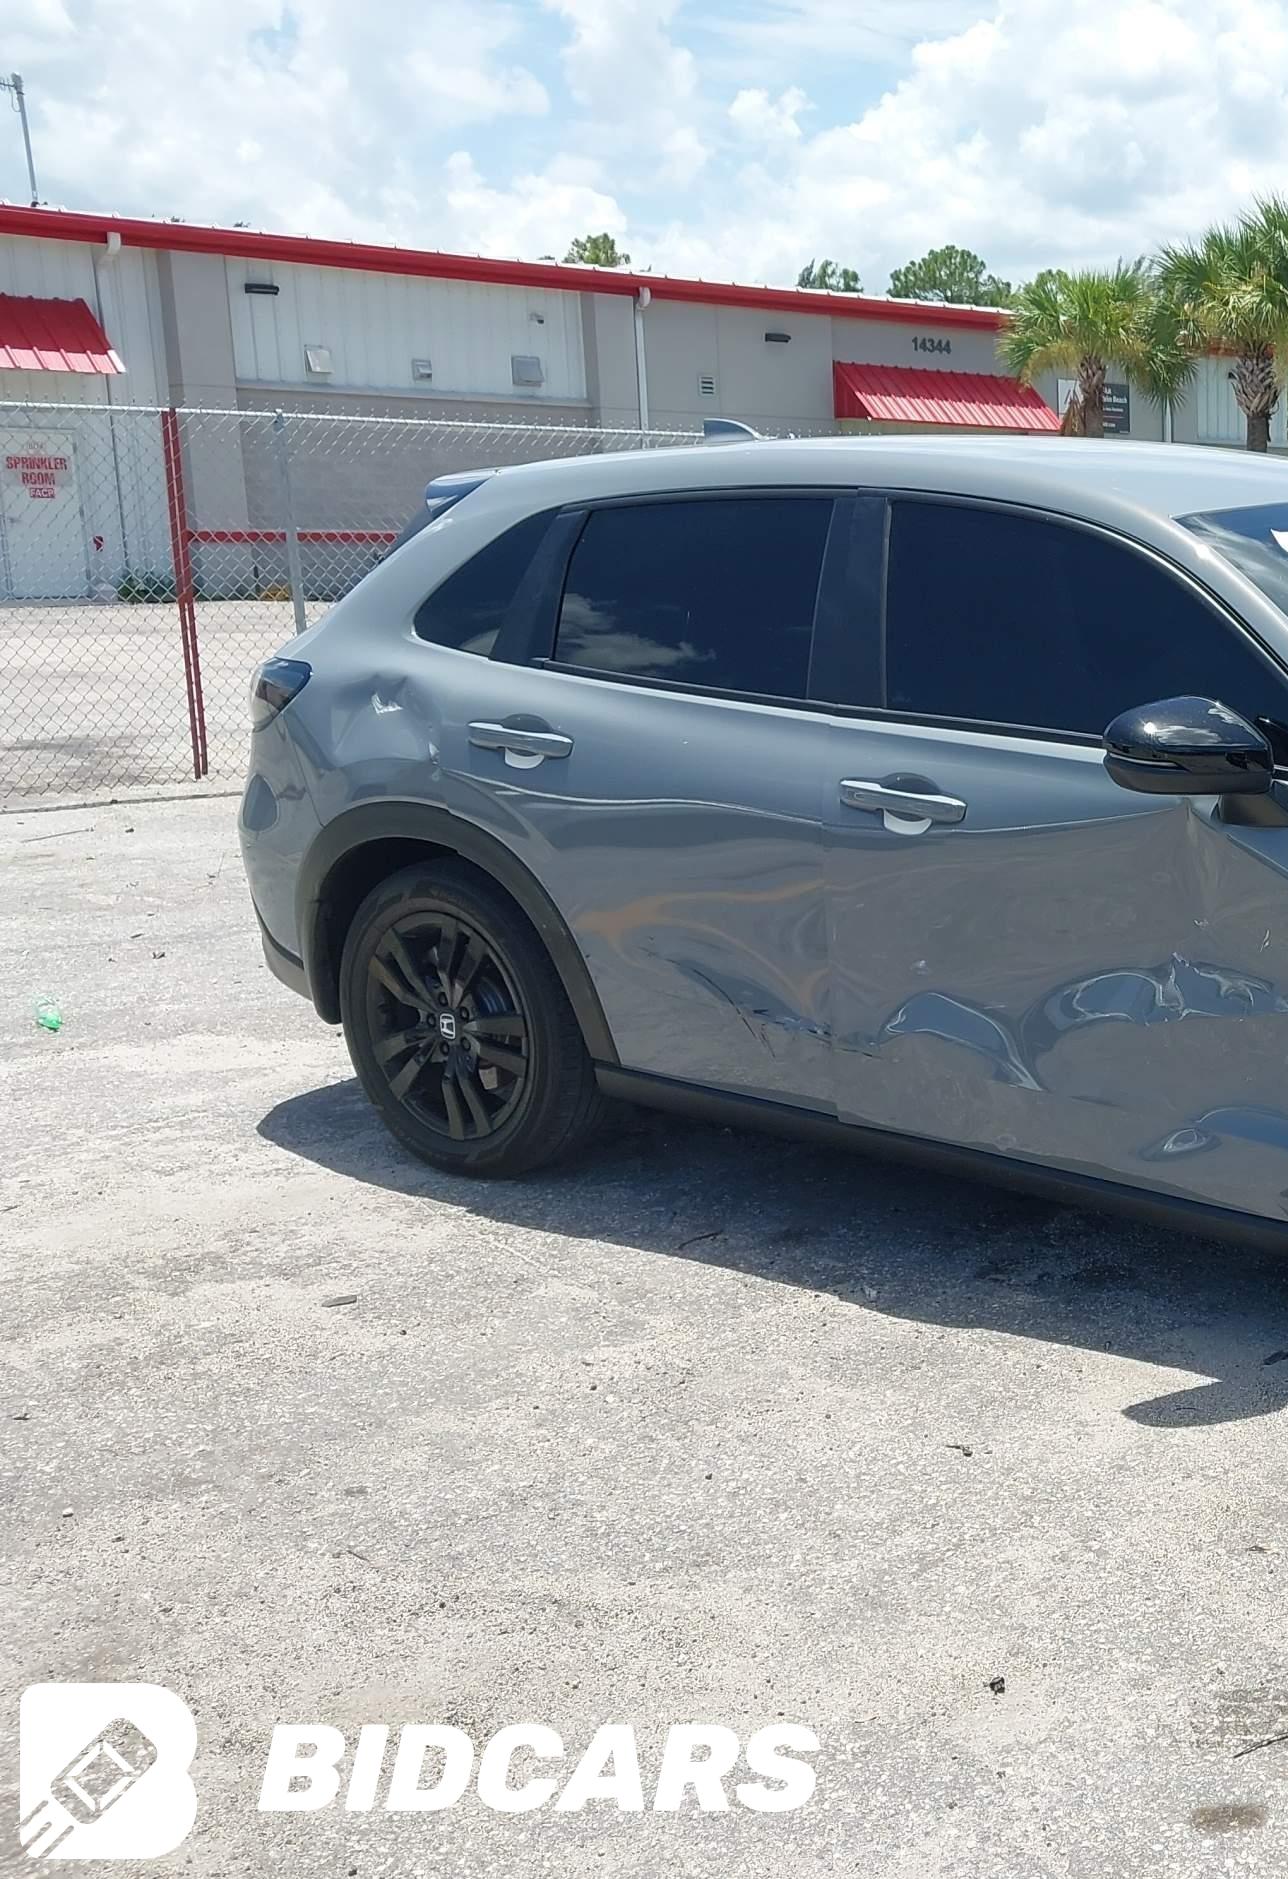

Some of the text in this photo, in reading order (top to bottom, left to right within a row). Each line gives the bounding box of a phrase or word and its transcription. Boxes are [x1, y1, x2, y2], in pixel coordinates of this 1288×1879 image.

[911, 336, 952, 354] 14344
[6, 456, 68, 470] SPRINKLER
[22, 472, 56, 485] ROOM
